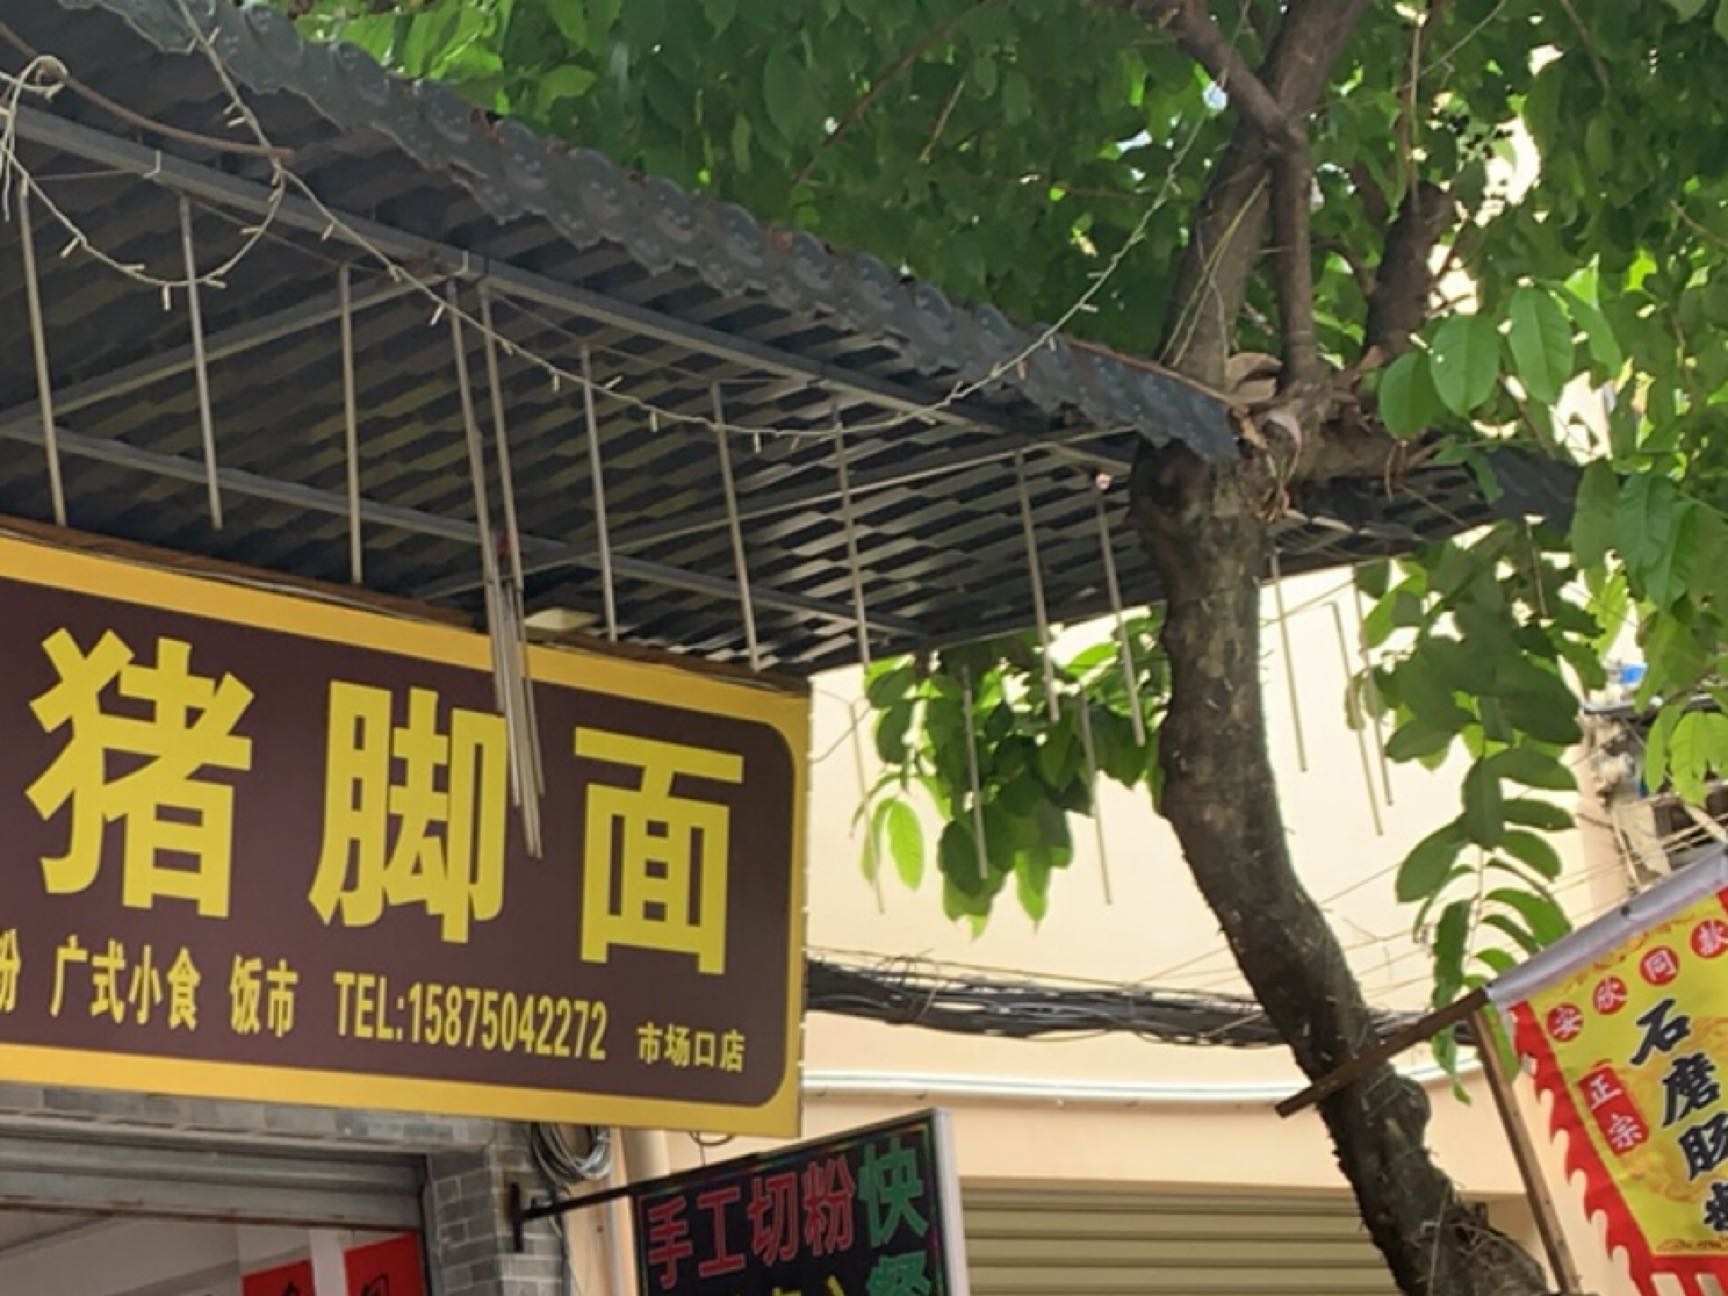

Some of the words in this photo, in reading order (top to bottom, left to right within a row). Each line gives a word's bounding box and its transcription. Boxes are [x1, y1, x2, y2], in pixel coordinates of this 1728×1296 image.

[50, 935, 203, 1033] 广式小食
[229, 954, 300, 1038] 饭市
[334, 971, 608, 1062] TEL:15875042272
[637, 1021, 747, 1073] 市场口店
[1587, 1077, 1644, 1152] 正宗
[647, 1152, 859, 1292] 手工切粉
